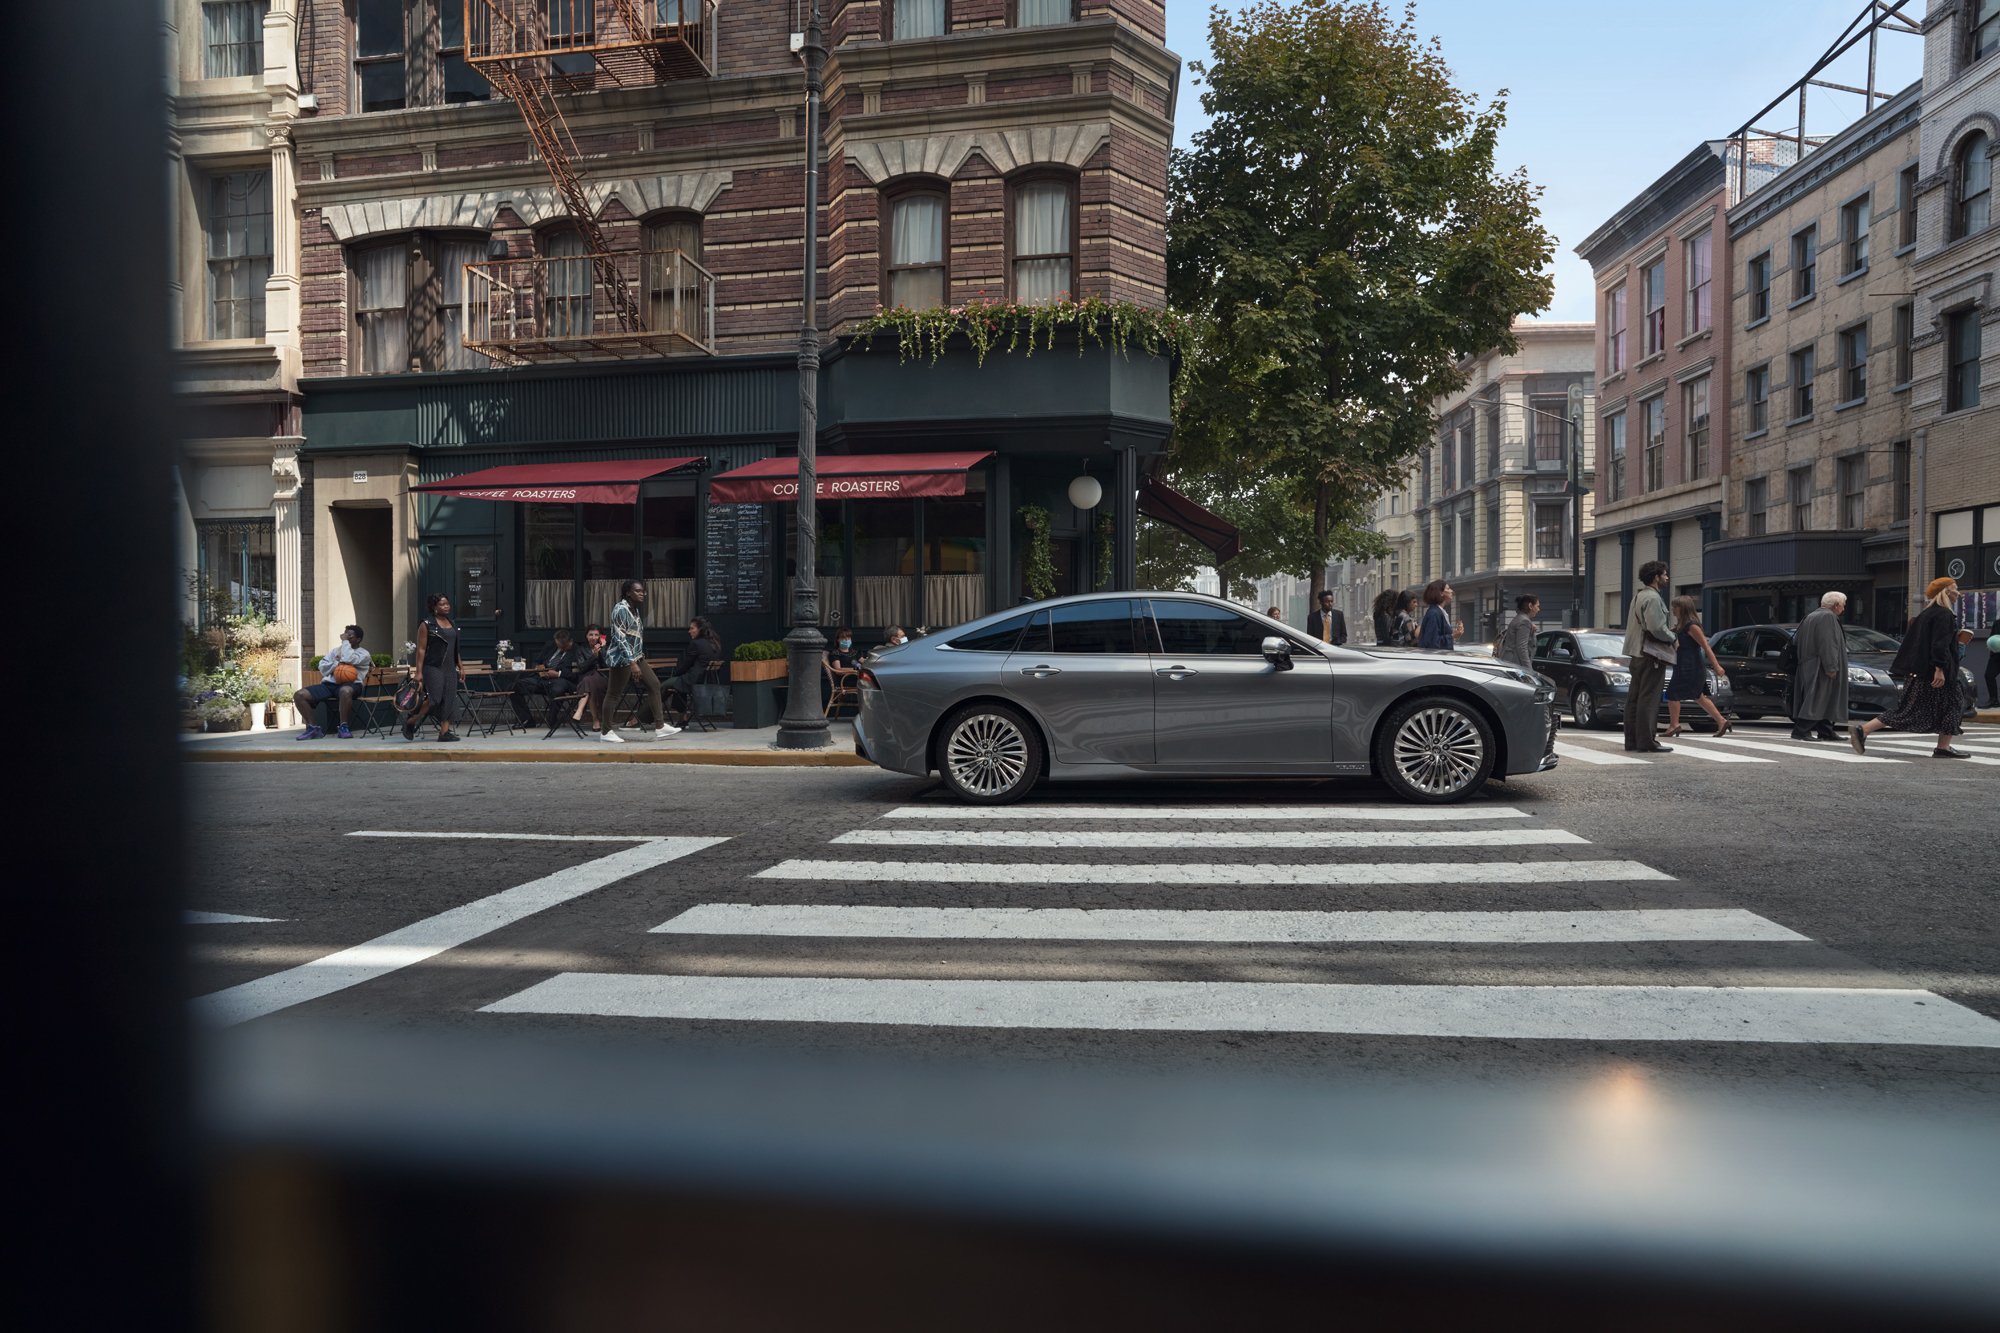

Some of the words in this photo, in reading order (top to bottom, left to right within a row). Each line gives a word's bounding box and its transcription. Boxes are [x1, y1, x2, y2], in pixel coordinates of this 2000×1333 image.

[773, 483, 824, 495] COFE
[831, 480, 900, 493] ROASTERS
[513, 490, 576, 499] ROASTERS
